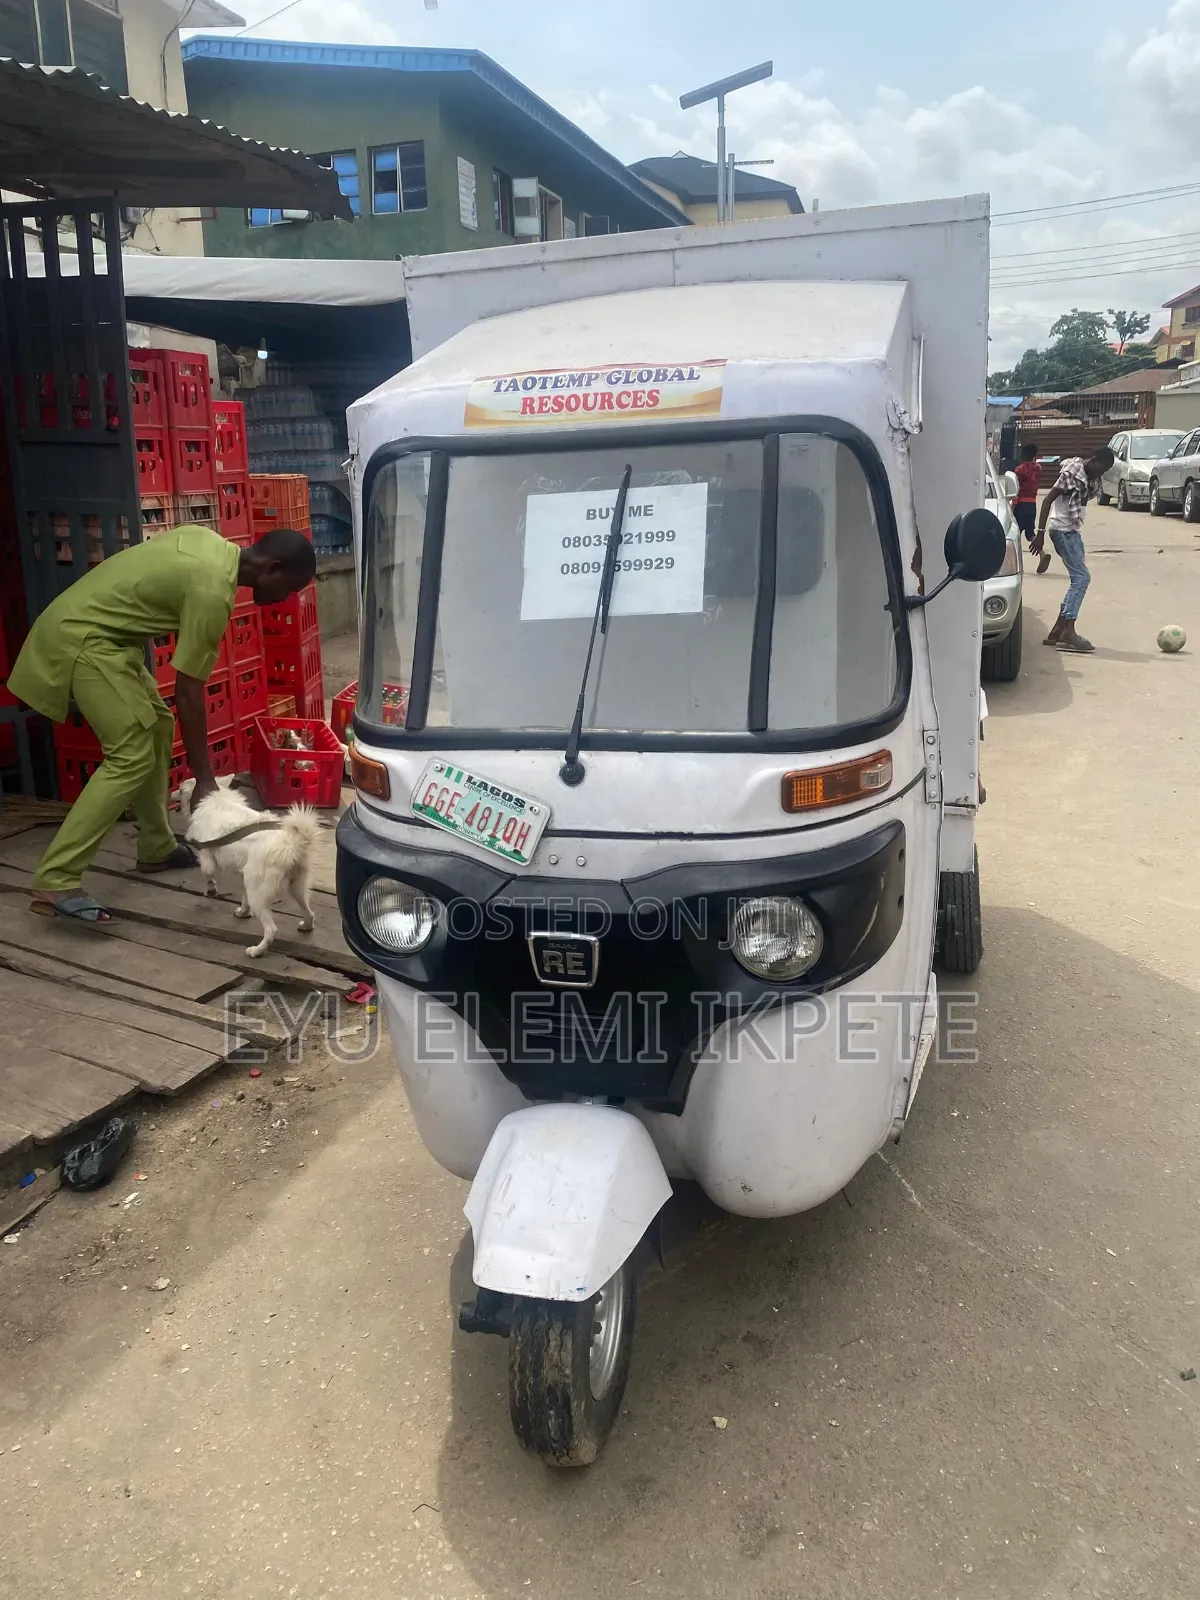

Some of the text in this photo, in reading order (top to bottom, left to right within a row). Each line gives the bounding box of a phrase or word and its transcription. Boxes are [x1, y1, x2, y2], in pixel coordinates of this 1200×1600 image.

[493, 366, 701, 393] TAOTEMP GLOBAL
[519, 388, 661, 416] RESOURCES
[586, 504, 654, 520] BU ME
[561, 529, 676, 549] 0803521999
[560, 556, 675, 575] 0809599929
[466, 774, 526, 808] LAGOS
[542, 949, 587, 976] RE
